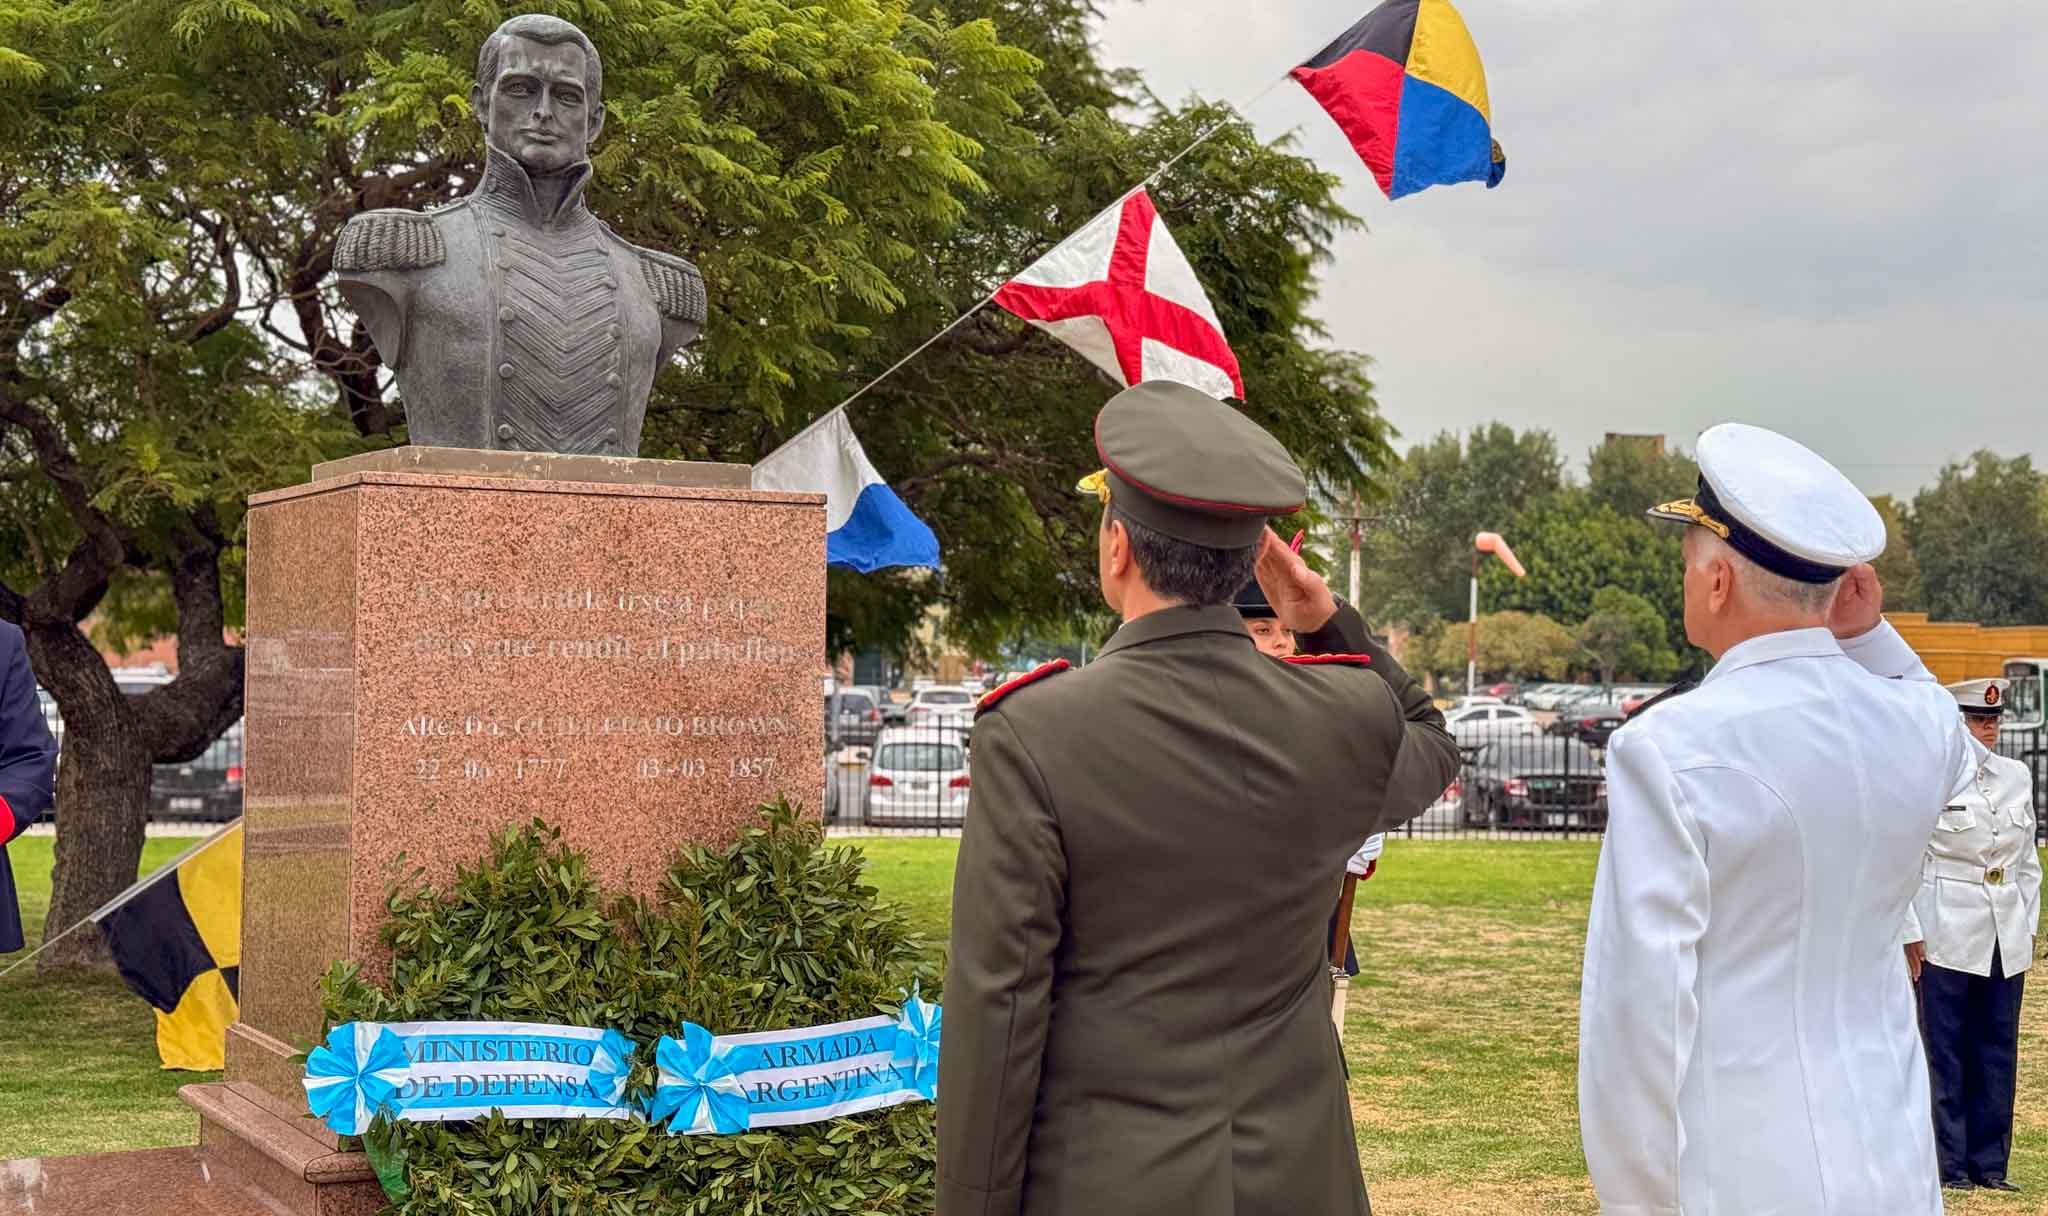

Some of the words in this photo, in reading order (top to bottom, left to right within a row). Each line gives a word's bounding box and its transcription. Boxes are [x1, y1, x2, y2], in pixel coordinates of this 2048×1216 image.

[402, 1040, 595, 1067] MINISTERIO
[757, 1033, 880, 1070] ARMADA
[392, 1075, 443, 1099] DE
[453, 1073, 600, 1099] DEFENSA
